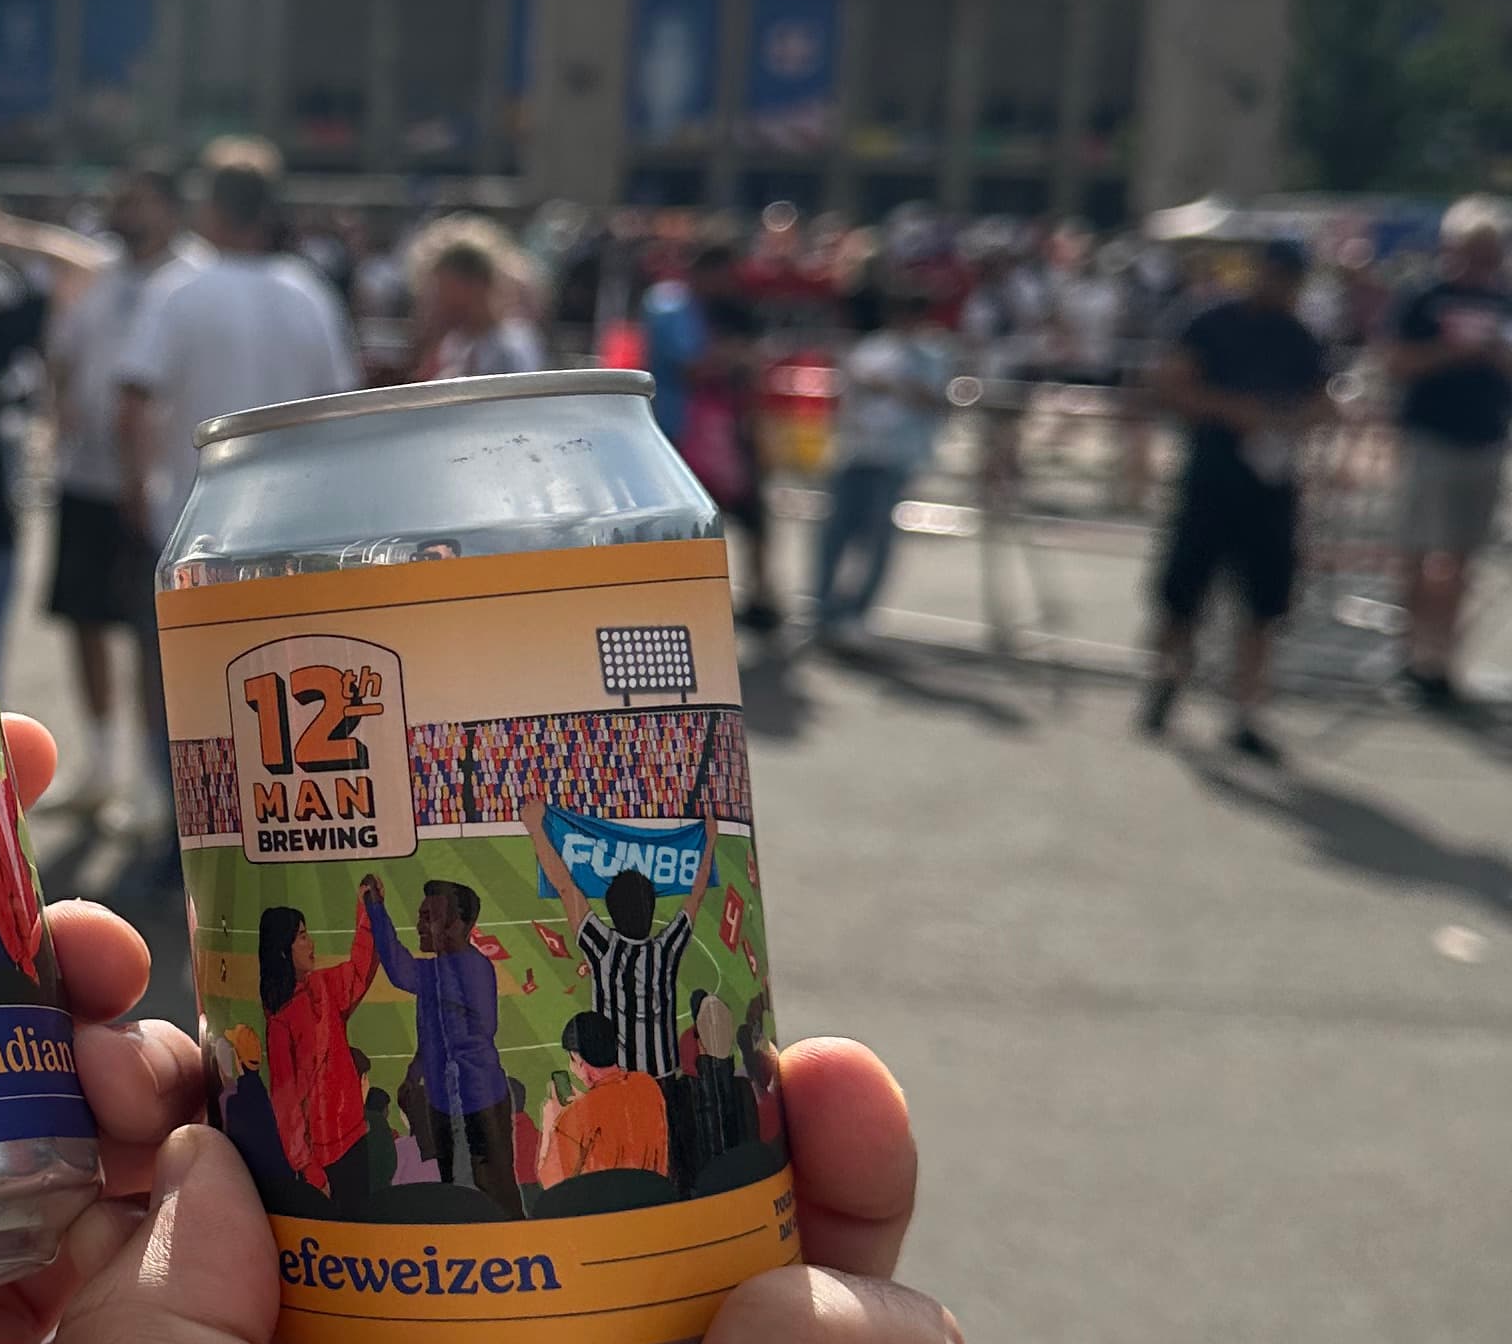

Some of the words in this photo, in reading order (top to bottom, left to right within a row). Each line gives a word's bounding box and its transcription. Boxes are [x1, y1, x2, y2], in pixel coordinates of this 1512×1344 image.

[244, 664, 384, 775] 12th
[253, 775, 376, 824] MAN
[257, 825, 379, 853] BREWING
[562, 832, 701, 887] FUN88
[279, 1237, 562, 1295] efeweizen
